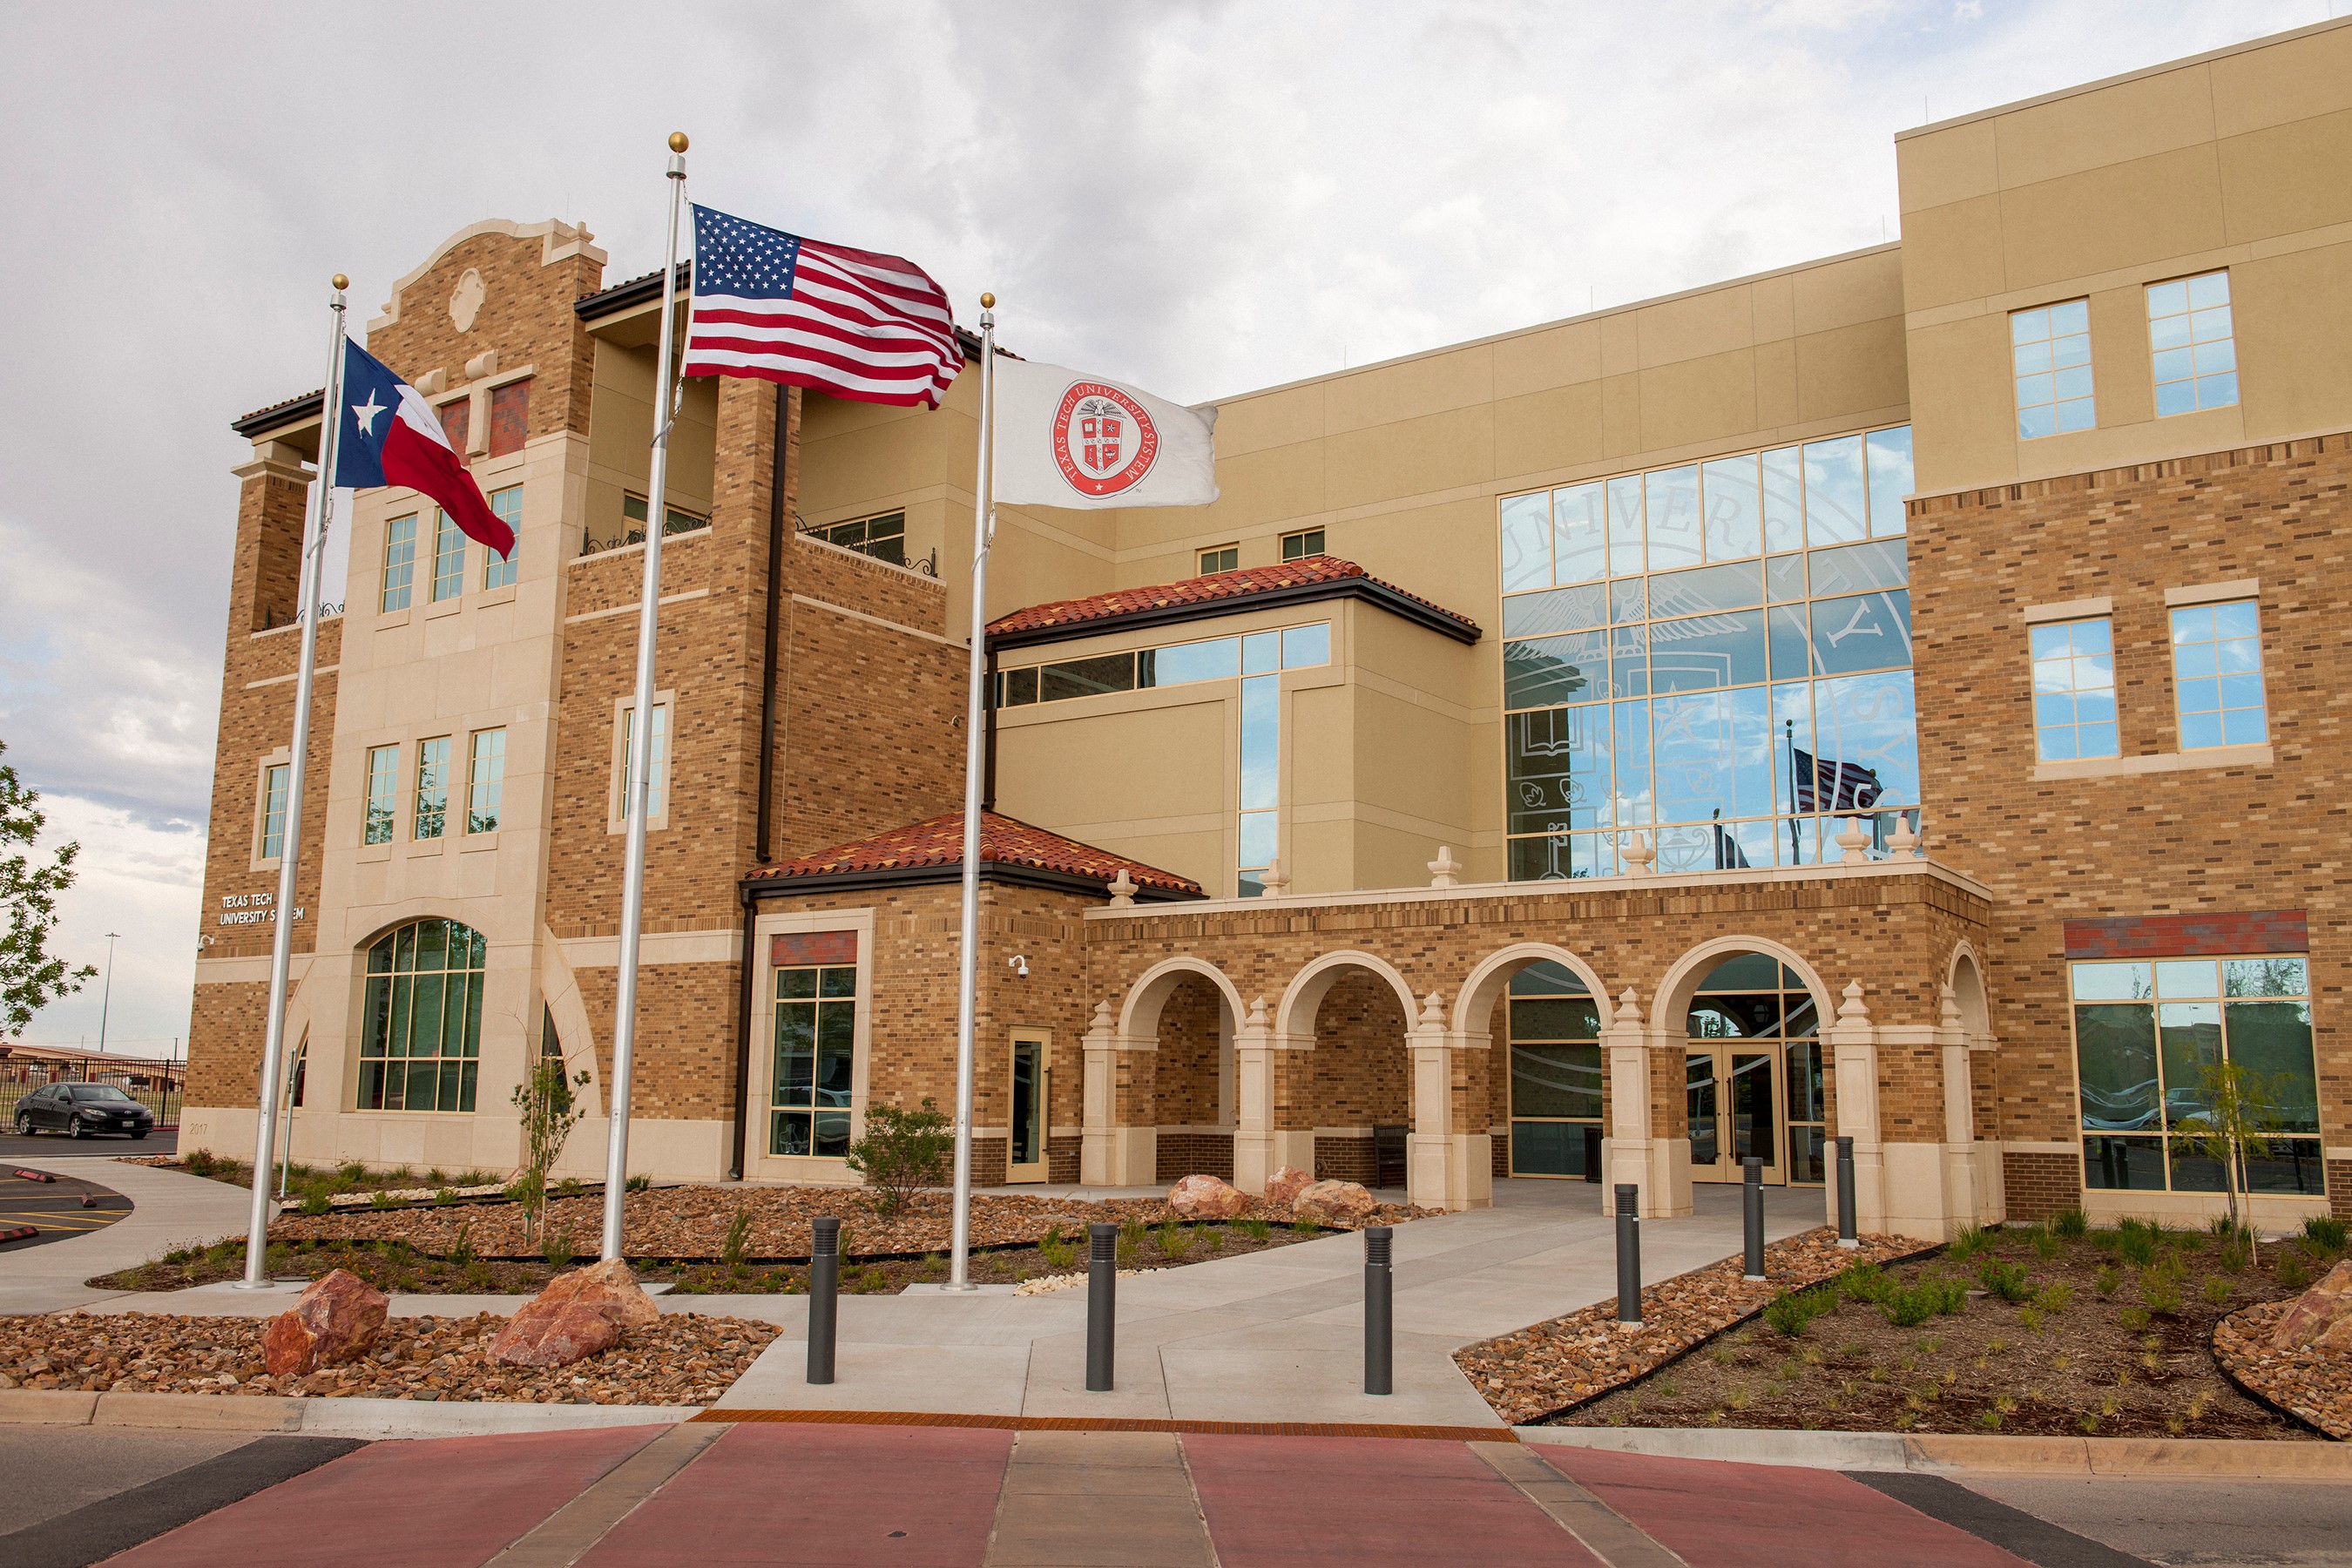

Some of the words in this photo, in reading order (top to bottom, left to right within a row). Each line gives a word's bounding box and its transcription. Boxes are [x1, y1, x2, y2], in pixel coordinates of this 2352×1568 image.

[1058, 395, 1075, 429] TECH
[1075, 384, 1151, 430] UNIVERSITY
[1057, 436, 1078, 481] TEXAS
[1125, 432, 1154, 480] SYSTEM
[220, 909, 267, 925] UNIVERSITY
[270, 907, 304, 922] SEM
[222, 895, 248, 908] TEXAS
[251, 893, 273, 906] TECH
[189, 1123, 207, 1135] 2017
